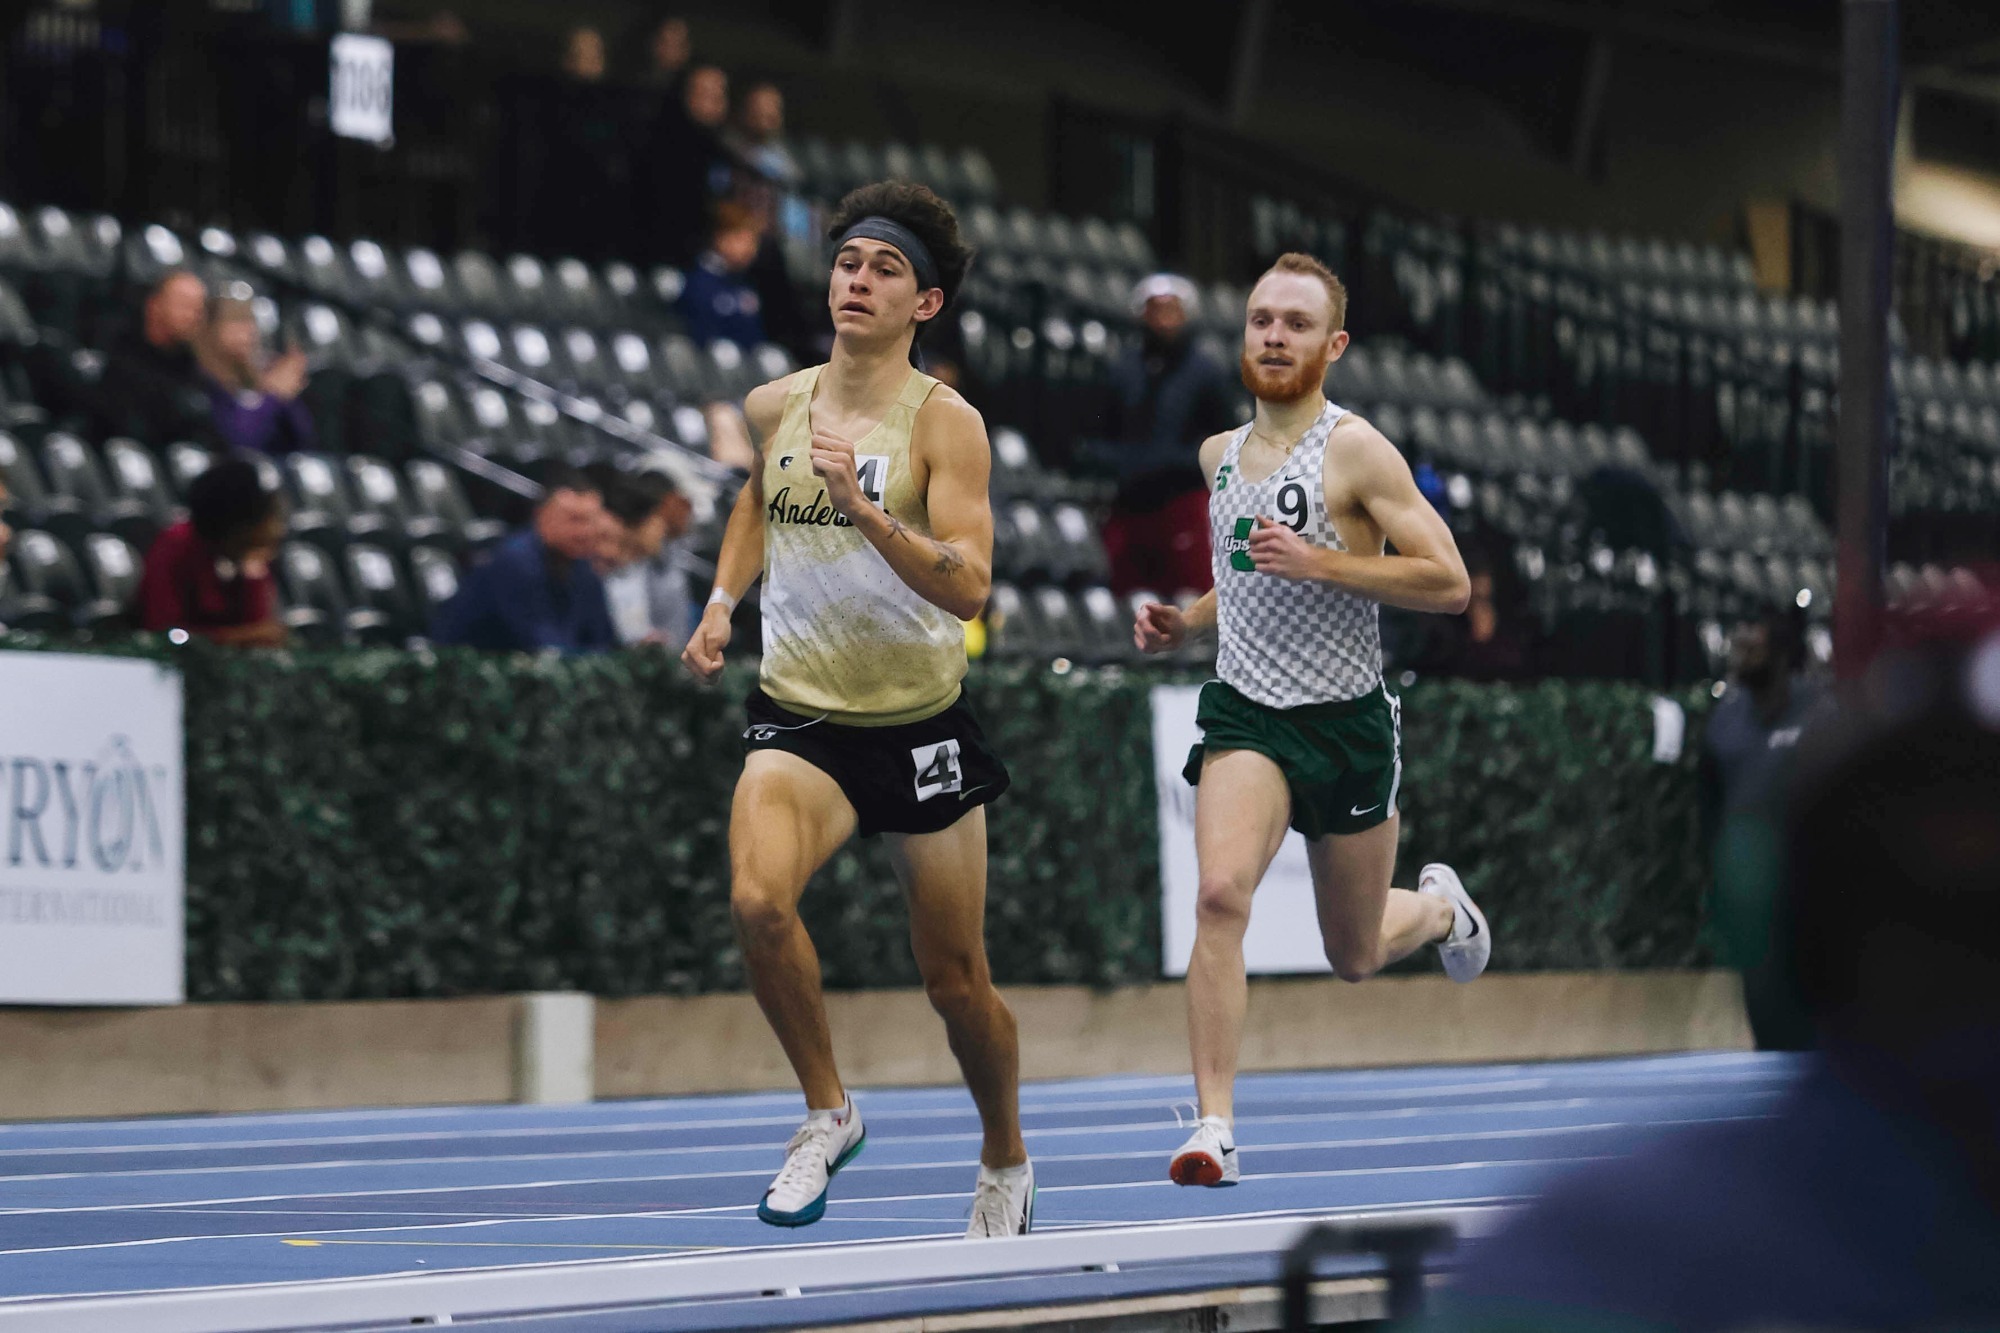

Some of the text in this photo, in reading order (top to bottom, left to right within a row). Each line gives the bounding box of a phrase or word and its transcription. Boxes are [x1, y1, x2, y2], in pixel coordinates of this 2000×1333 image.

[768, 486, 886, 527] Ander
[1277, 483, 1308, 533] 9
[1224, 535, 1251, 553] Ups
[917, 744, 958, 790] 4
[0, 756, 168, 874] RYON
